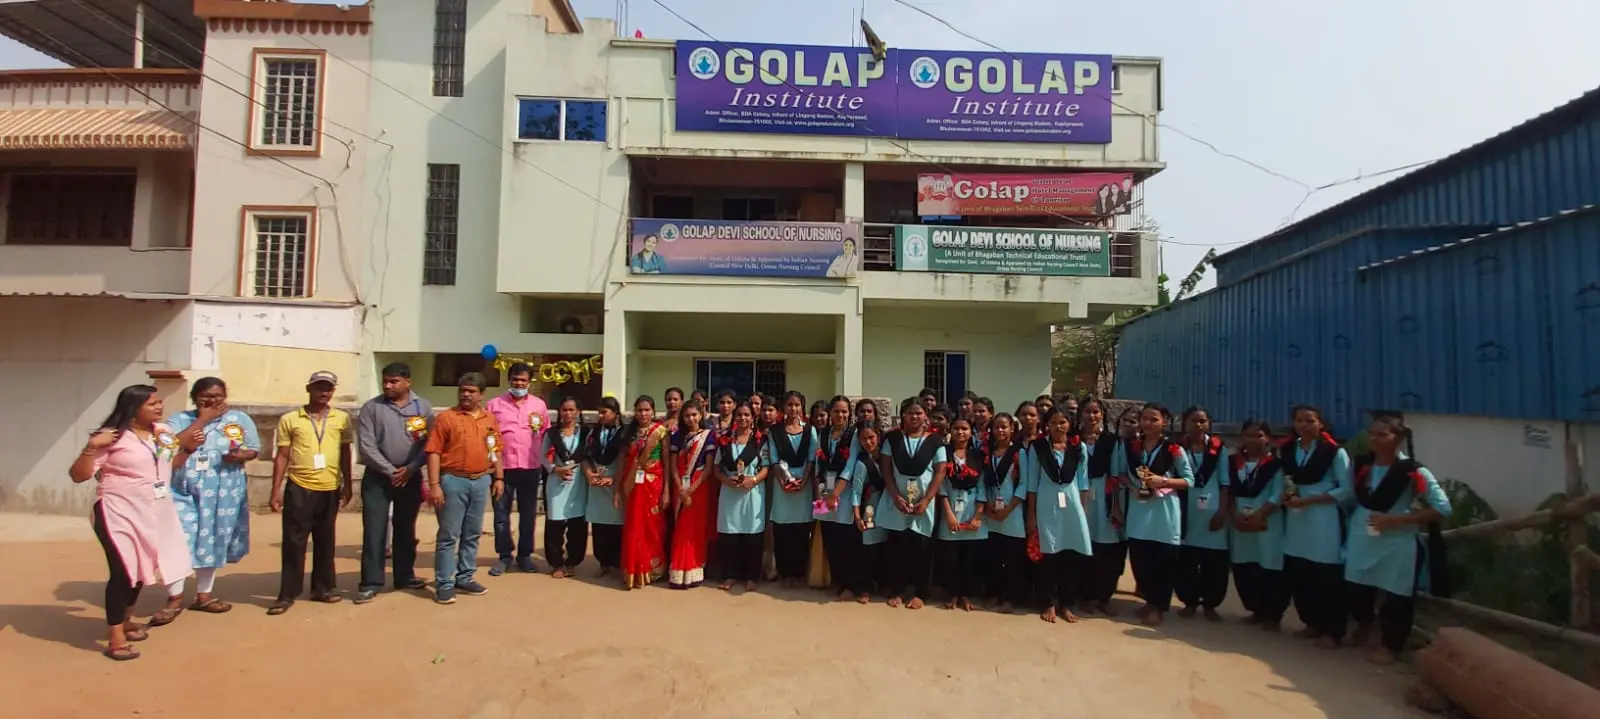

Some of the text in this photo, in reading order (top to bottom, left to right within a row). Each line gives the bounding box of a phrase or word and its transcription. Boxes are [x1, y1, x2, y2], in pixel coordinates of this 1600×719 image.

[724, 48, 885, 88] GOLAP
[945, 57, 1100, 94] GOLAP
[729, 87, 864, 109] Institute
[949, 96, 1080, 116] Institute
[954, 179, 1030, 203] Golap
[682, 224, 716, 239] GOLAP
[718, 226, 740, 240] DEVI
[742, 226, 781, 240] SCHOOL
[784, 227, 797, 240] OF
[798, 227, 842, 241] NURSING
[932, 230, 969, 248] GOLAP
[970, 231, 994, 249] DEVI
[995, 232, 1037, 250] SCHOOL
[1038, 233, 1053, 250] OF
[1054, 234, 1102, 252] NURSING
[967, 250, 974, 258] of
[975, 250, 1005, 259] Bhagaban
[1034, 252, 1068, 260] Educational
